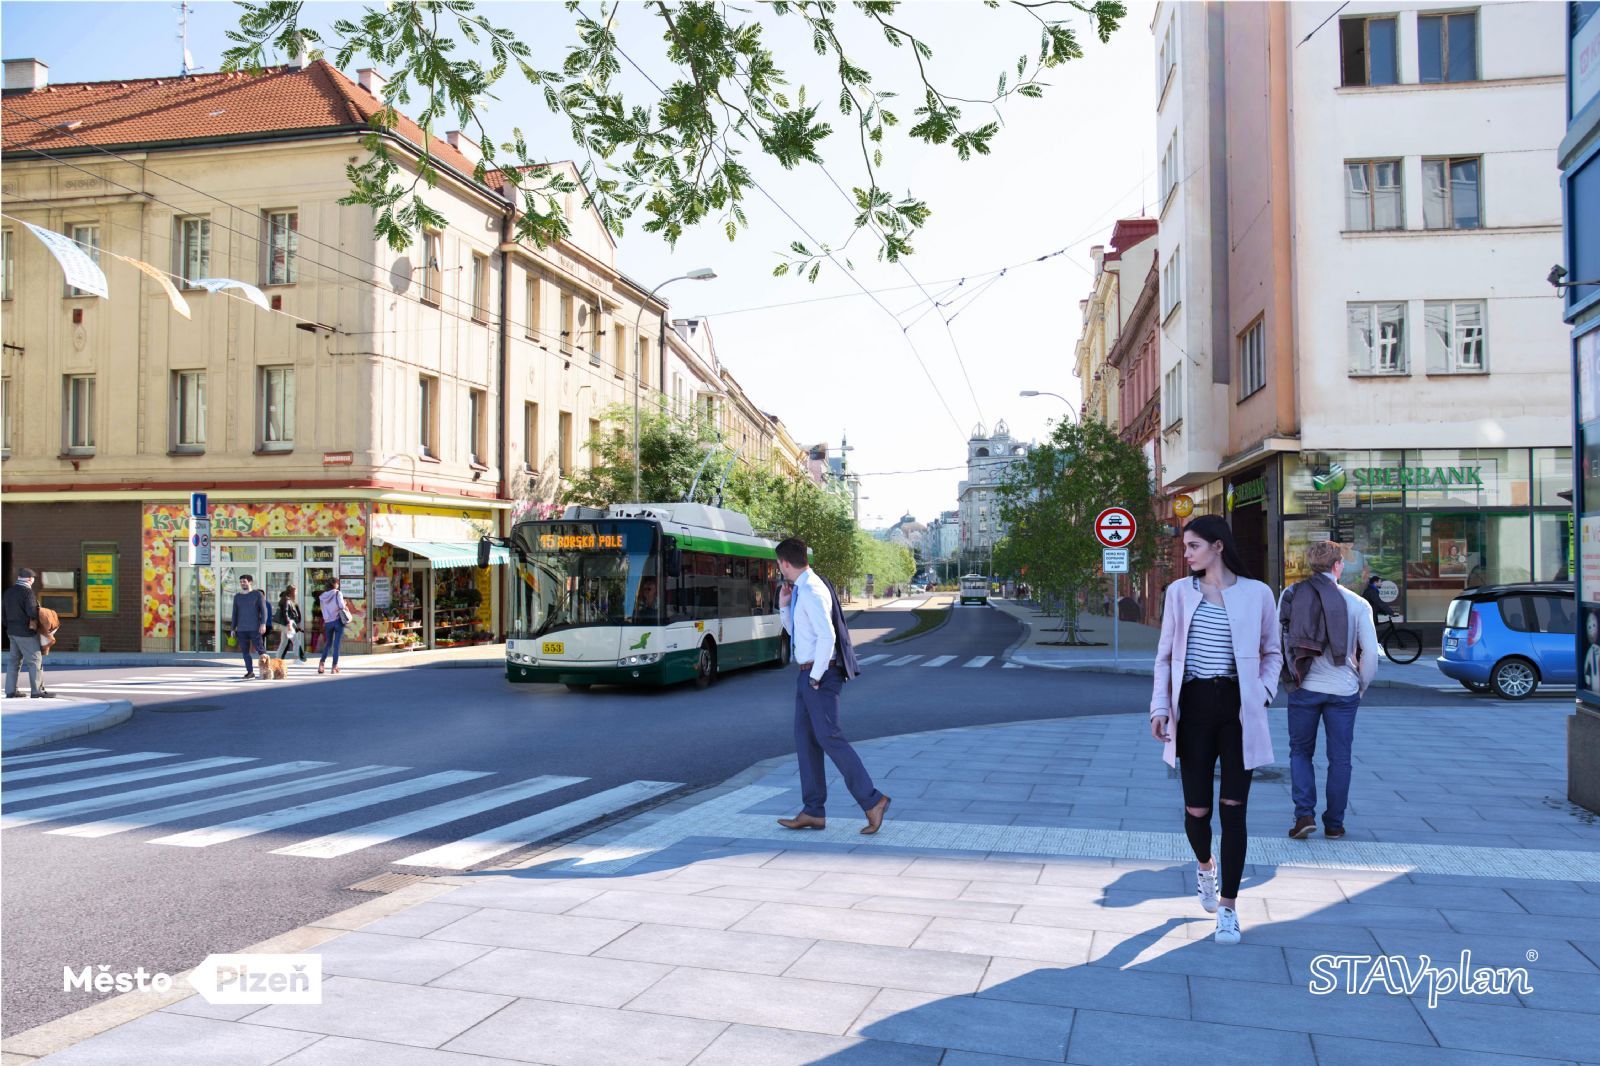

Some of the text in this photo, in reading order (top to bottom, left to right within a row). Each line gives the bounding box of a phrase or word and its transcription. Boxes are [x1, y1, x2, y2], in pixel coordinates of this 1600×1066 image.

[1353, 466, 1484, 485] SBERBANK
[1175, 500, 1189, 510] 24
[152, 513, 255, 532] Kviny
[540, 534, 555, 548] 15
[598, 535, 623, 548] POLE
[543, 642, 562, 653] 553
